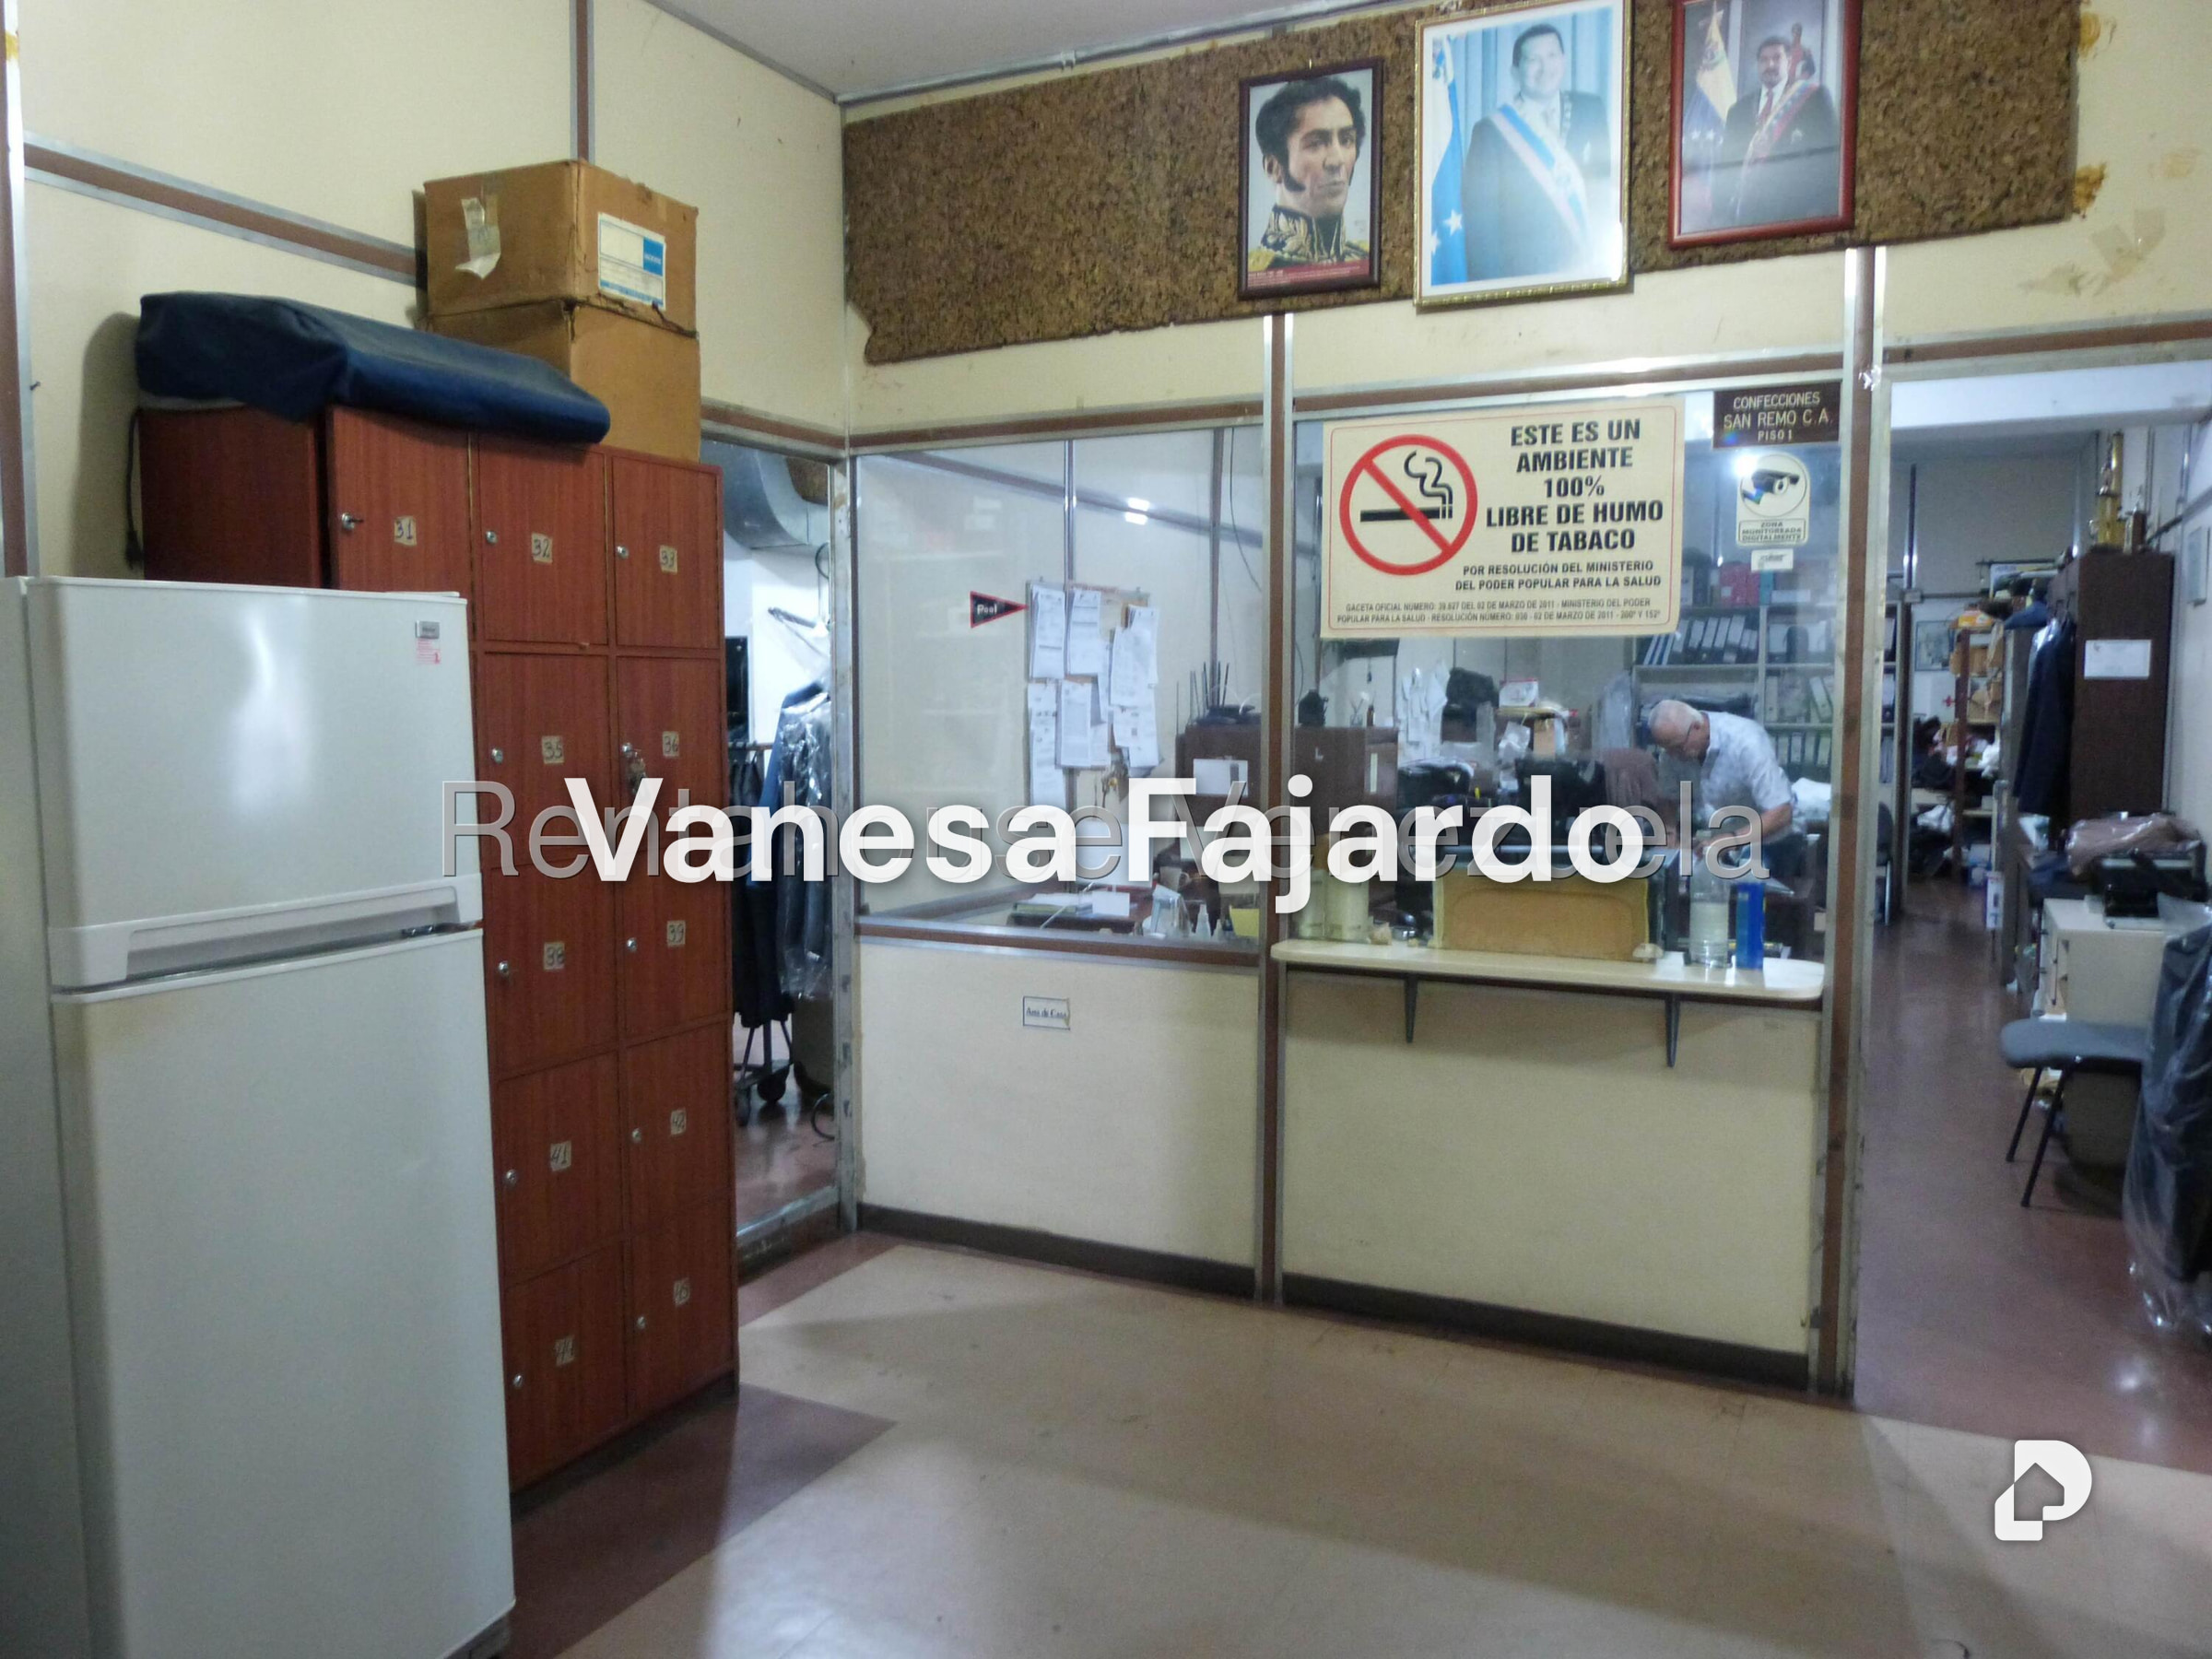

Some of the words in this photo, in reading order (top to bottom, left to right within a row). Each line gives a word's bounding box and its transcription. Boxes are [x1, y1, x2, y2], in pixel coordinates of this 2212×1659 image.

[1733, 392, 1821, 409] CONFECCIONES
[1724, 413, 1751, 429] SAN
[1758, 410, 1796, 428] REMO
[1511, 424, 1563, 446] ESTE
[1571, 421, 1599, 443] ES
[1607, 418, 1641, 441] UN
[1758, 429, 1784, 441] PISO
[1516, 446, 1633, 473] AMBIENTE
[1543, 476, 1605, 499] 100%
[1486, 505, 1549, 528] LIBRE
[1556, 503, 1585, 525] DE
[1593, 500, 1664, 523] HUMO
[394, 521, 414, 540] 31
[533, 538, 550, 559] 32
[1512, 532, 1539, 554] DE
[1547, 529, 1635, 551] TABACO
[660, 550, 676, 569] 33
[1463, 565, 1485, 576] POR
[1488, 561, 1559, 575] RESOLUCIÓN
[1561, 562, 1583, 573] DEL
[1586, 560, 1653, 572] MINISTERIO
[1455, 580, 1476, 591] DEL
[1478, 579, 1514, 590] PODER
[1518, 578, 1570, 589] POPULAR
[1572, 577, 1602, 588] PARA
[1606, 576, 1619, 587] LA
[1623, 575, 1661, 586] SALUD
[1346, 603, 1373, 612] GACETA
[1375, 602, 1402, 611] OFICIAL
[1461, 601, 1476, 610] DEL
[1487, 600, 1497, 609] DE
[1499, 600, 1525, 609] MARZO
[1526, 599, 1537, 609] DE
[1561, 598, 1605, 608] MINISTERIO
[1606, 598, 1621, 607] DEL
[1623, 598, 1651, 607] PODER
[1337, 615, 1370, 624] POPULAR
[1371, 614, 1390, 623] PARA
[1391, 614, 1401, 623] LA
[1402, 614, 1426, 623] SALUD
[1544, 611, 1554, 620] DE
[1556, 610, 1583, 620] MARZO
[1584, 610, 1595, 619] DE
[1597, 610, 1614, 619] 2011
[552, 1145, 568, 1164] 41
